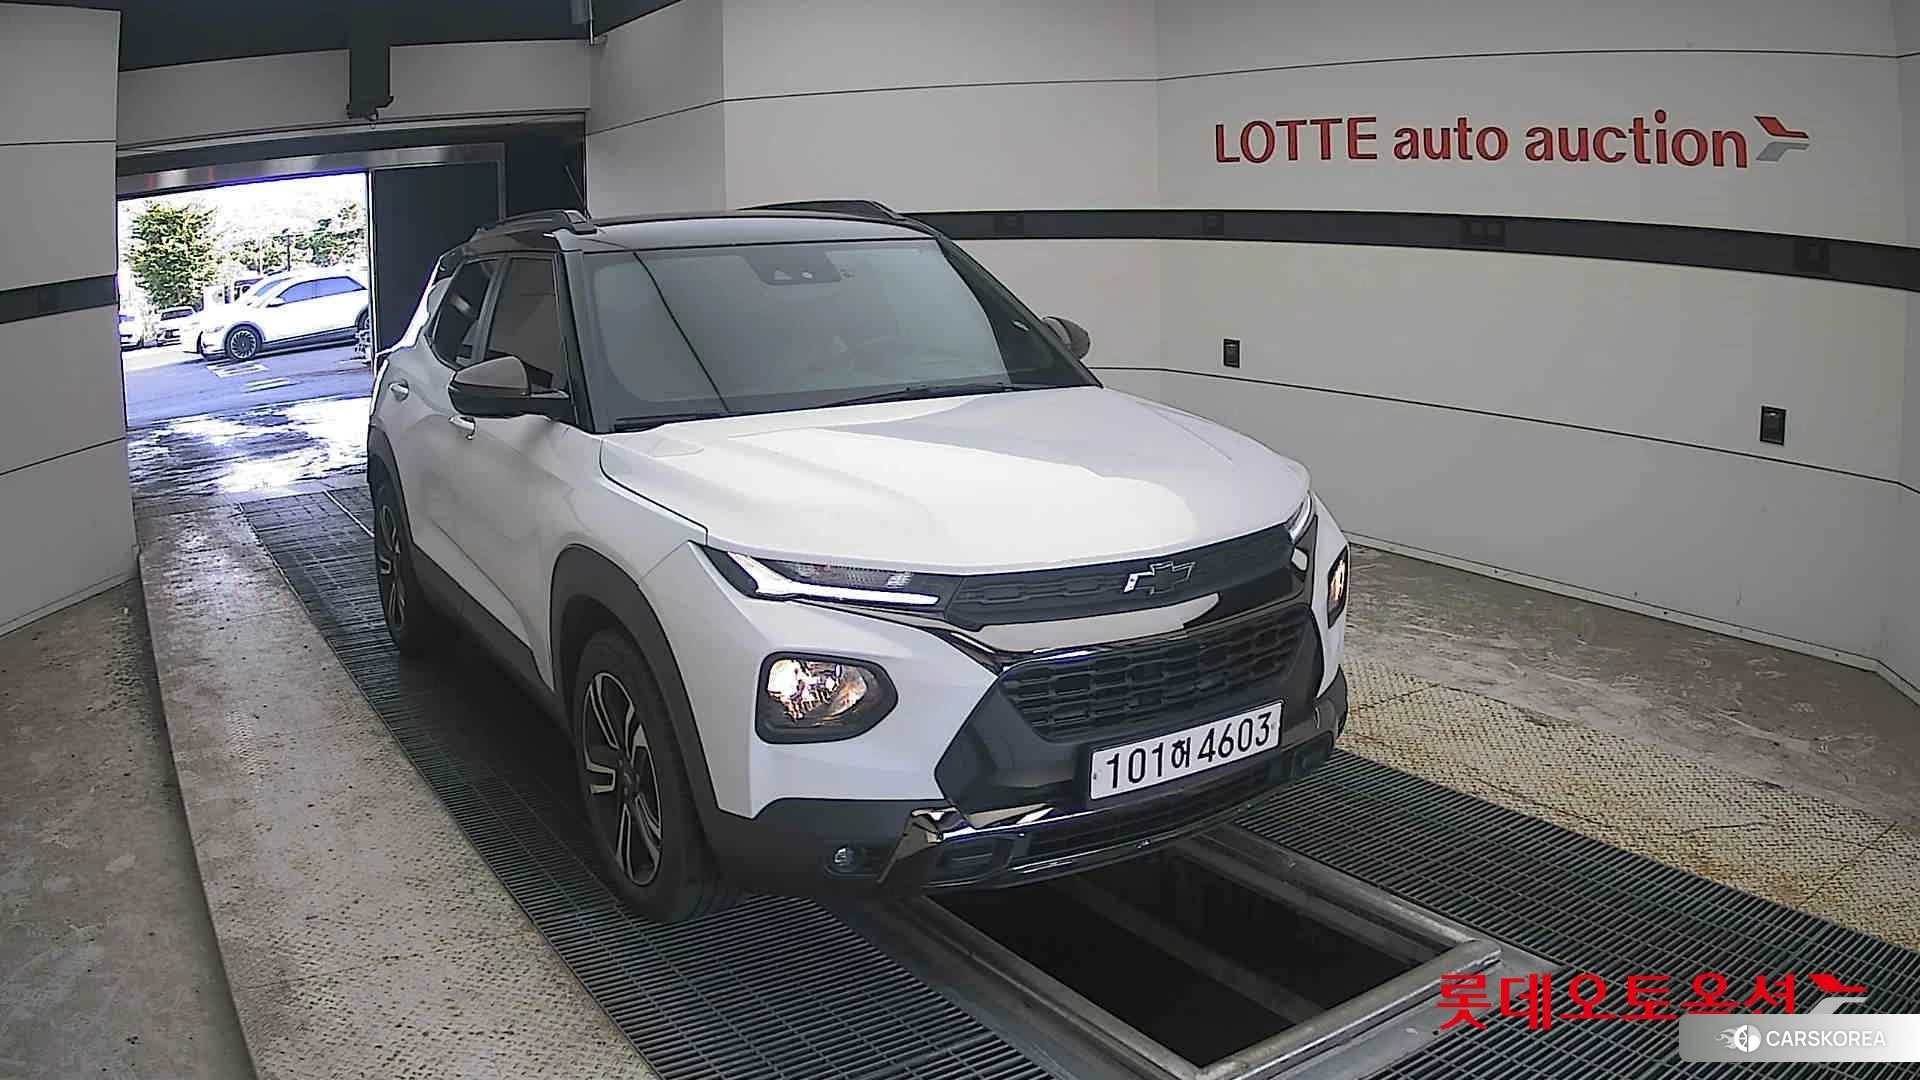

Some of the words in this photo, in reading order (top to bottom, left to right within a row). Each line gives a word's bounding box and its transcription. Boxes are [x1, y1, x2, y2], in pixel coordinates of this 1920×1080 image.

[1215, 116, 1377, 163] LOTTE
[1392, 117, 1509, 162] auto
[1523, 110, 1748, 168] auction
